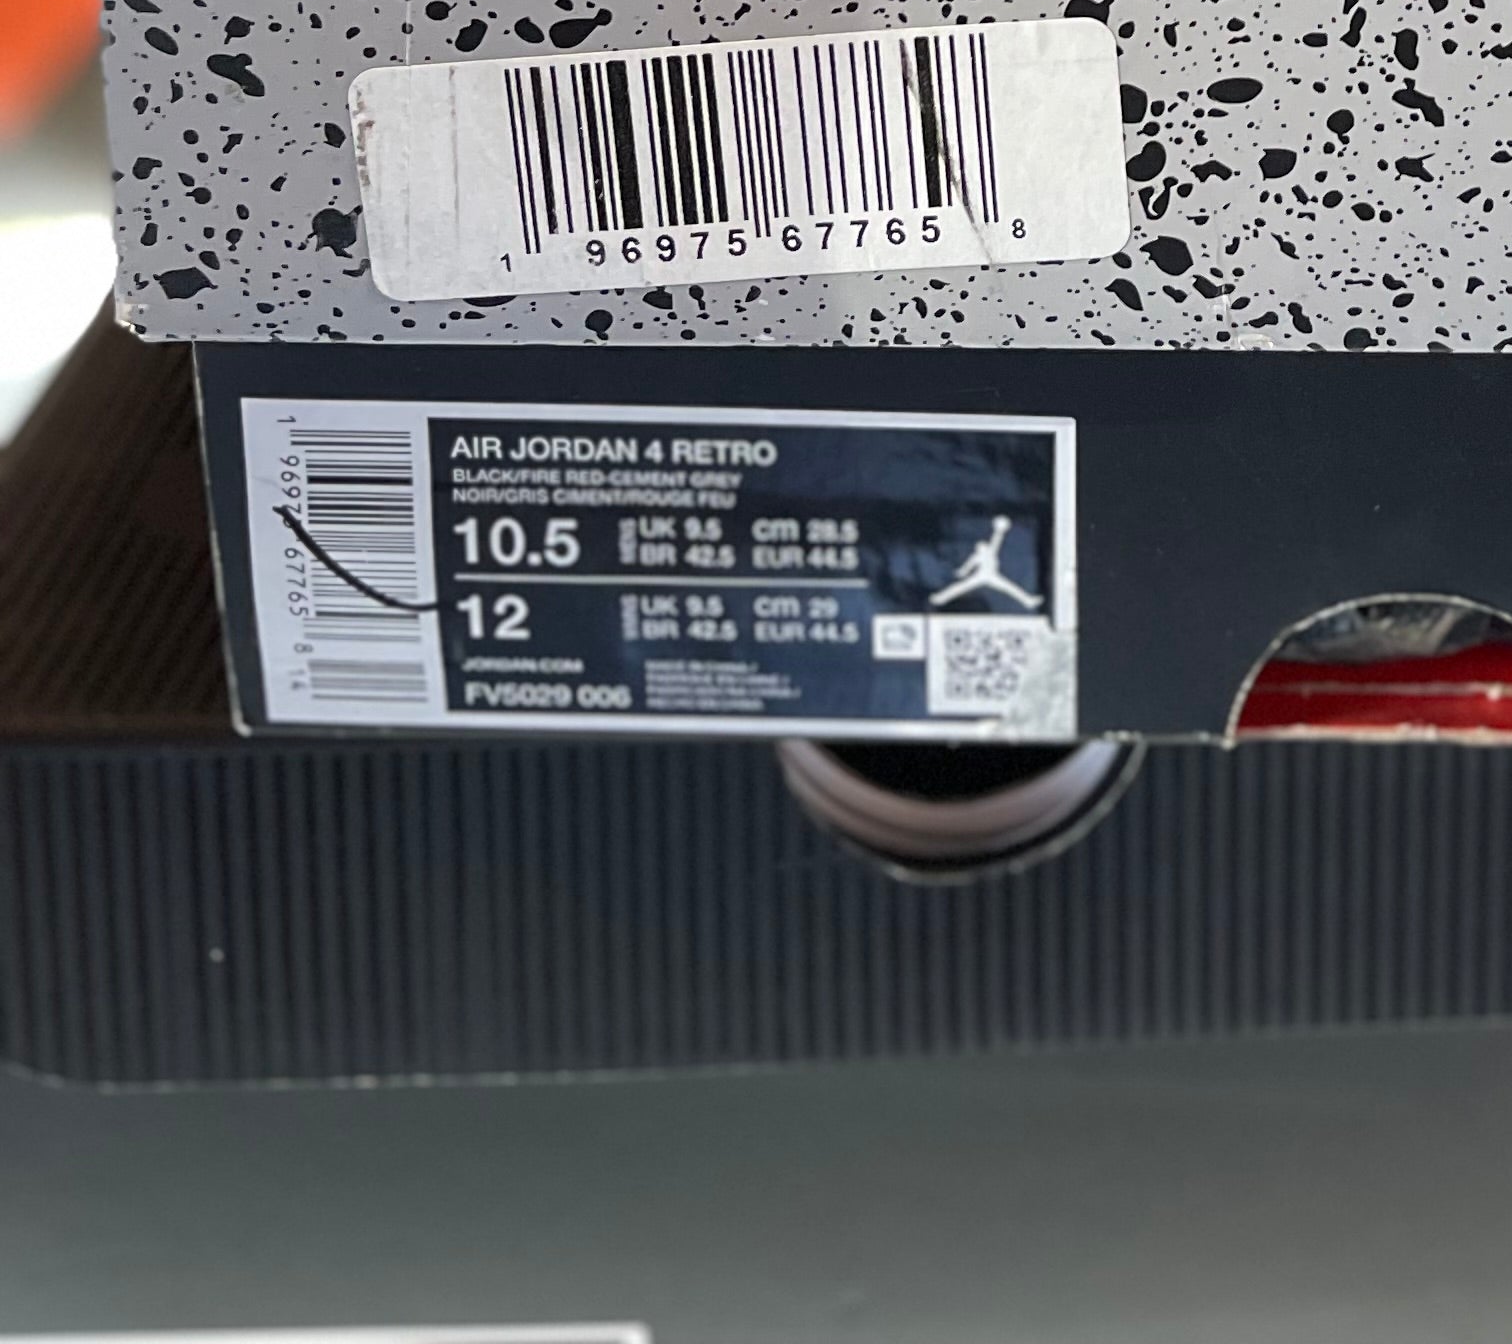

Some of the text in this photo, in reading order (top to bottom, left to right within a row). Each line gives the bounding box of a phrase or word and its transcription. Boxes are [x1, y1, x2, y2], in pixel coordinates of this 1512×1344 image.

[500, 215, 1027, 272] 1 96975 67765 8
[451, 436, 778, 467] AIR JORDAN 4 RETRO
[452, 468, 561, 485] BLACK/FIRE
[453, 487, 549, 505] NOIR/GRIS
[697, 490, 737, 510] FEU
[453, 516, 581, 567] 10.5
[639, 515, 677, 539] UK
[684, 516, 722, 542] 9.5
[752, 545, 804, 570] EUR
[284, 547, 309, 617] 67765
[456, 593, 531, 641] 12
[641, 594, 679, 617] UK
[685, 595, 724, 618] 9.5
[754, 620, 805, 643] EUR
[465, 681, 572, 707] FV5029
[576, 684, 632, 709] 006
